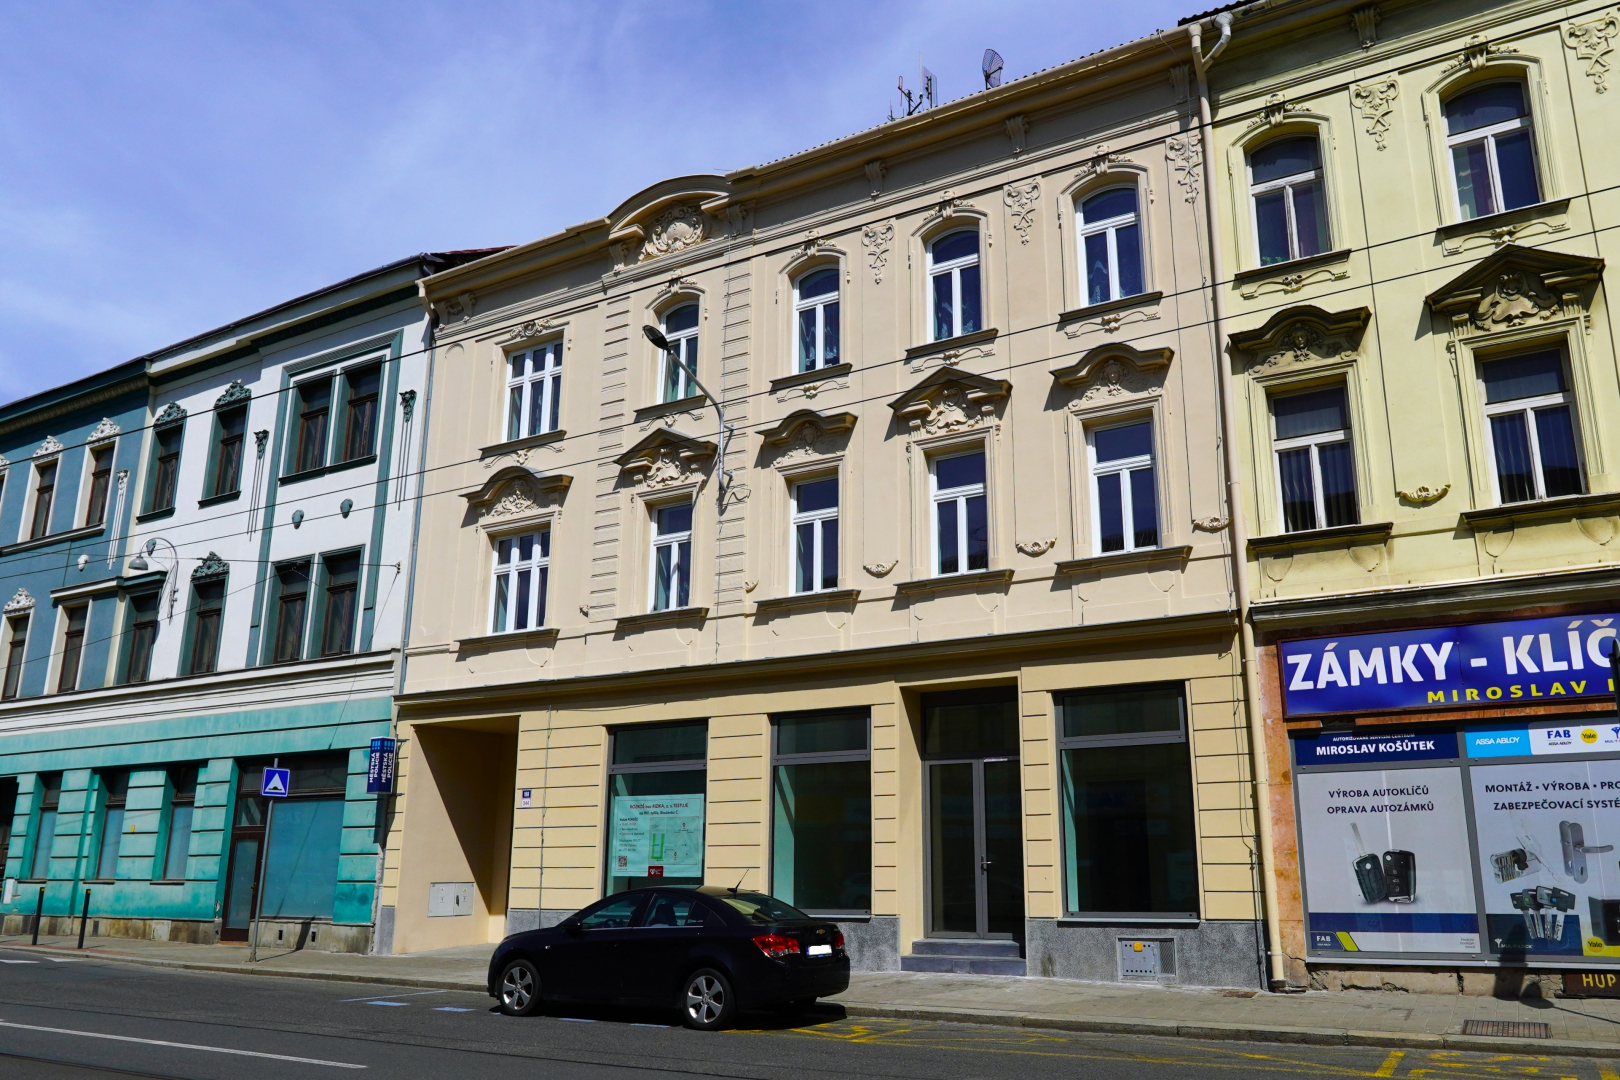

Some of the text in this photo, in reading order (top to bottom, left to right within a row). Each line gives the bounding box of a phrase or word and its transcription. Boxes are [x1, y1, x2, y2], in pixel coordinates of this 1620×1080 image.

[1287, 642, 1454, 691] ZÁMKY
[1427, 680, 1587, 703] MIROSLAV
[1496, 736, 1520, 744] ABLOY
[1547, 729, 1571, 739] FAB
[1316, 740, 1435, 756] MIROSLAV KOŠŮTEK
[1328, 785, 1429, 798] VÝROBA AUTOKLÍČŮ
[1485, 781, 1533, 793] MONTÁŽ
[1542, 780, 1590, 791] VÝROBA
[1327, 801, 1434, 814] OPRAVA AUTOZÁMKŮ
[1493, 798, 1583, 811] ZABEZPEČOVACÍ
[1582, 973, 1617, 988] HUP
